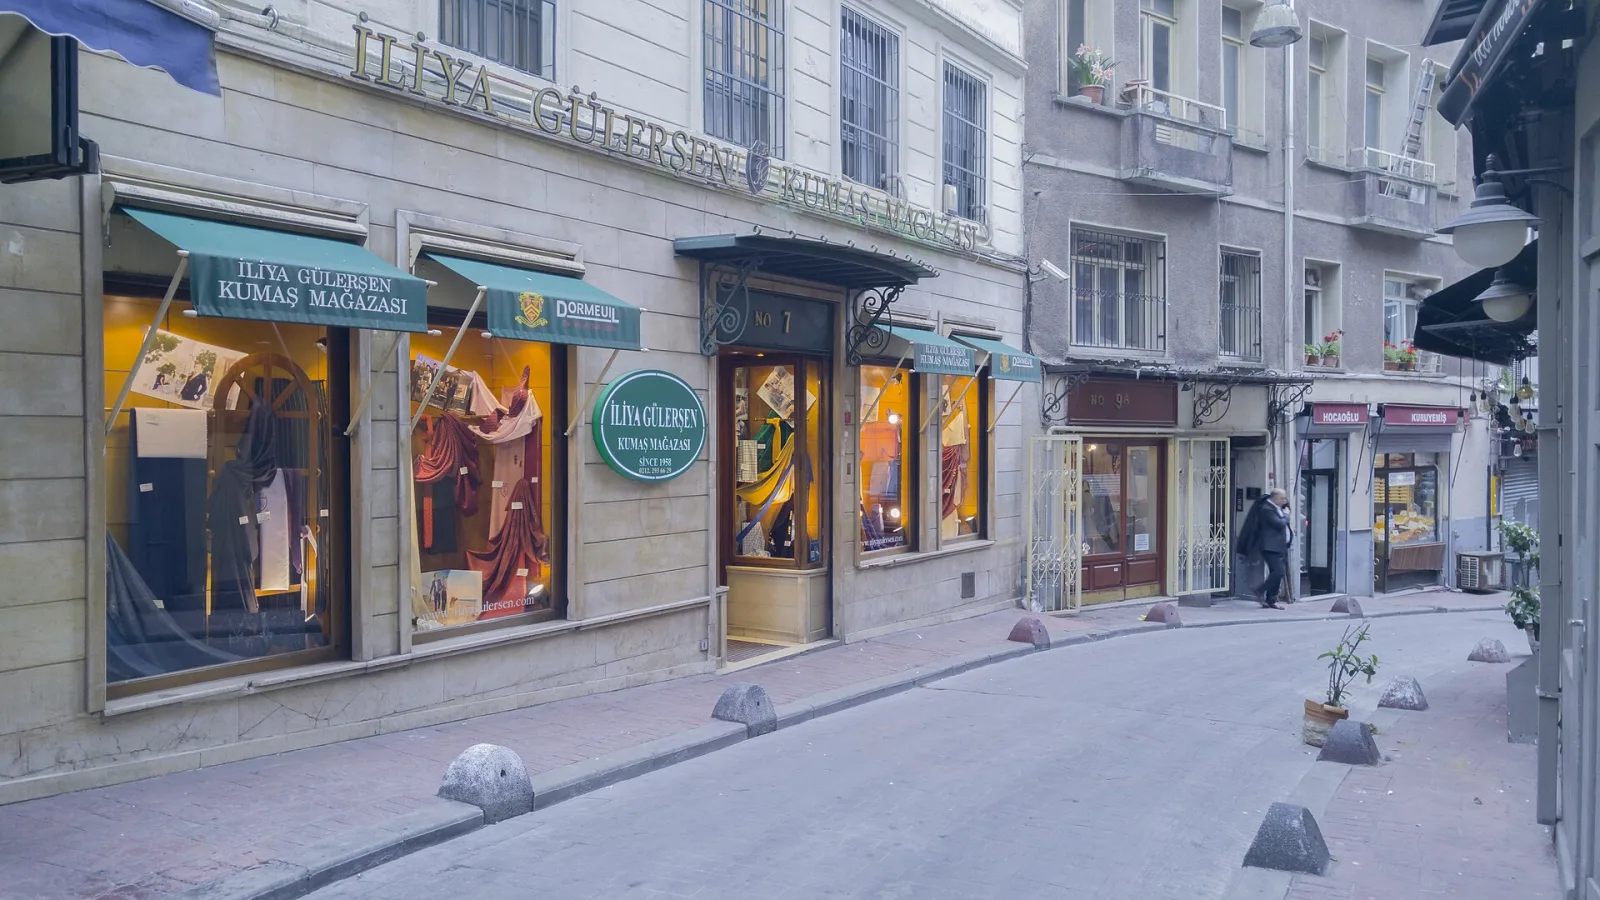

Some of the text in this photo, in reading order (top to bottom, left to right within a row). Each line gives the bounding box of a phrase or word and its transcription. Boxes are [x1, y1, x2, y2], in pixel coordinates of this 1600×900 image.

[350, 11, 498, 117] İLİYA
[533, 84, 733, 185] GÜLERŞEN
[782, 166, 870, 226] KUMAŞ
[238, 257, 392, 294] İLİYA GÜLERŞEN
[218, 280, 408, 315] KUMAŞ MAĞAZASI
[556, 300, 620, 324] DORMEUIL
[755, 311, 791, 334] NO 7
[920, 354, 942, 367] KUMAŞ
[1091, 394, 1105, 406] NO
[610, 400, 698, 433] İLİYA GÜLERŞEN
[1323, 411, 1359, 422] HOCAOĞLU
[1411, 412, 1447, 424] KURUYEMİŞ
[618, 436, 691, 453] KUMAŞ MAĞAZASI
[659, 458, 672, 467] 1958
